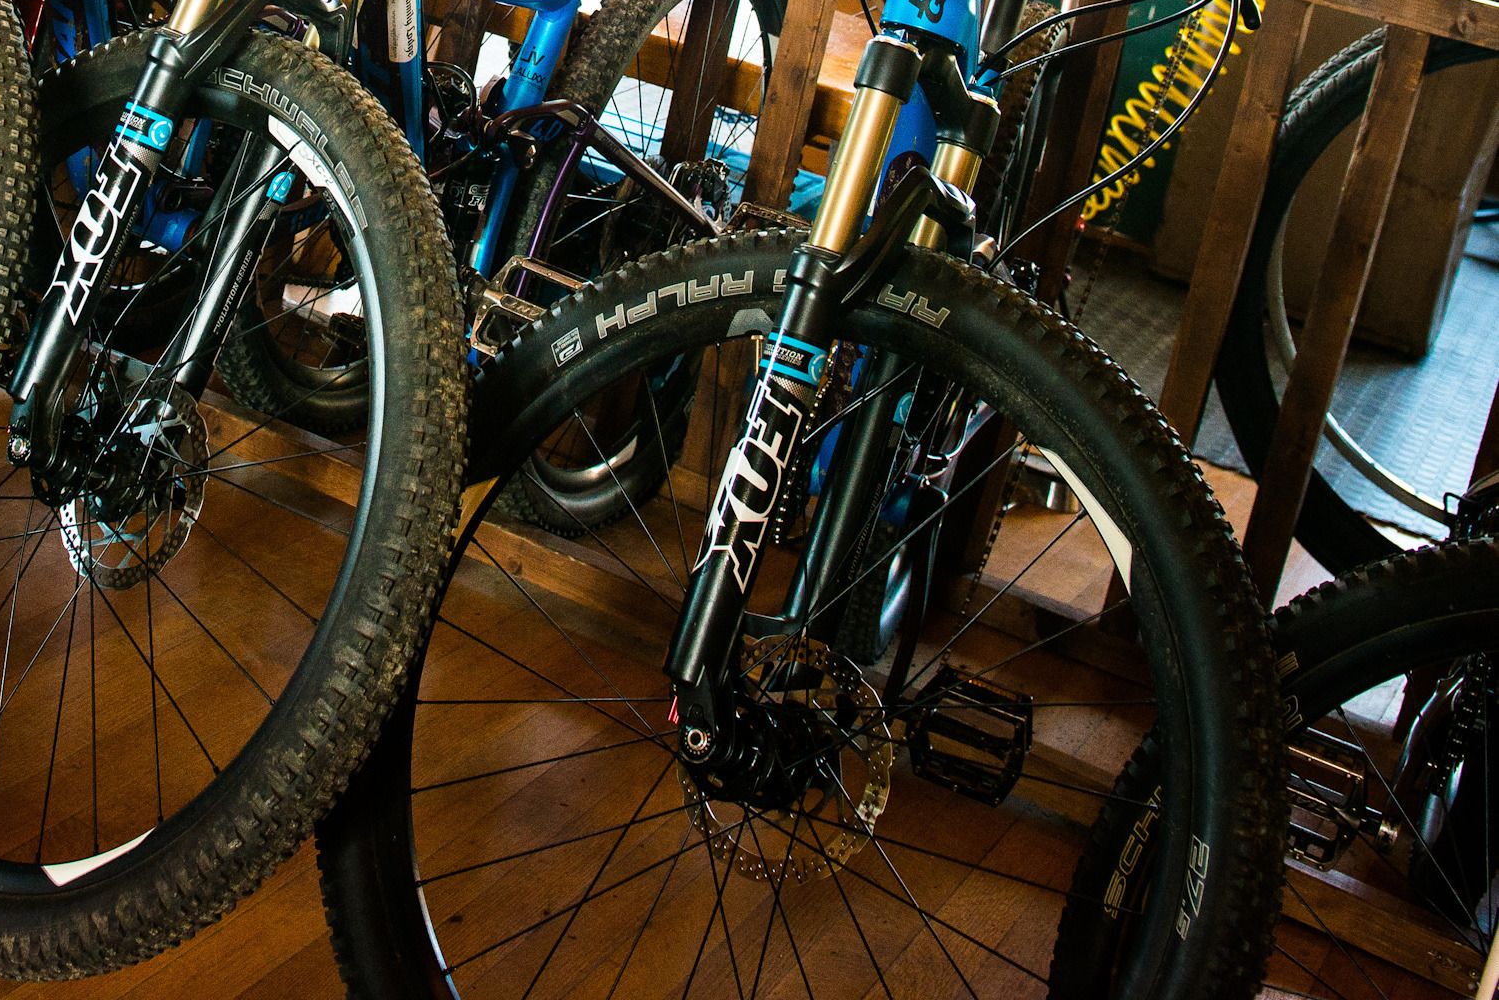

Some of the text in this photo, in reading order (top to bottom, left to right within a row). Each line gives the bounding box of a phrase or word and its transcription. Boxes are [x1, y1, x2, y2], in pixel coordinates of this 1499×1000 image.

[405, 24, 416, 57] Lodge
[40, 141, 142, 326] FOX
[237, 250, 253, 285] SERIES
[595, 270, 755, 339] RALPH
[691, 379, 803, 595] FOX
[1175, 834, 1210, 942] 27.5
